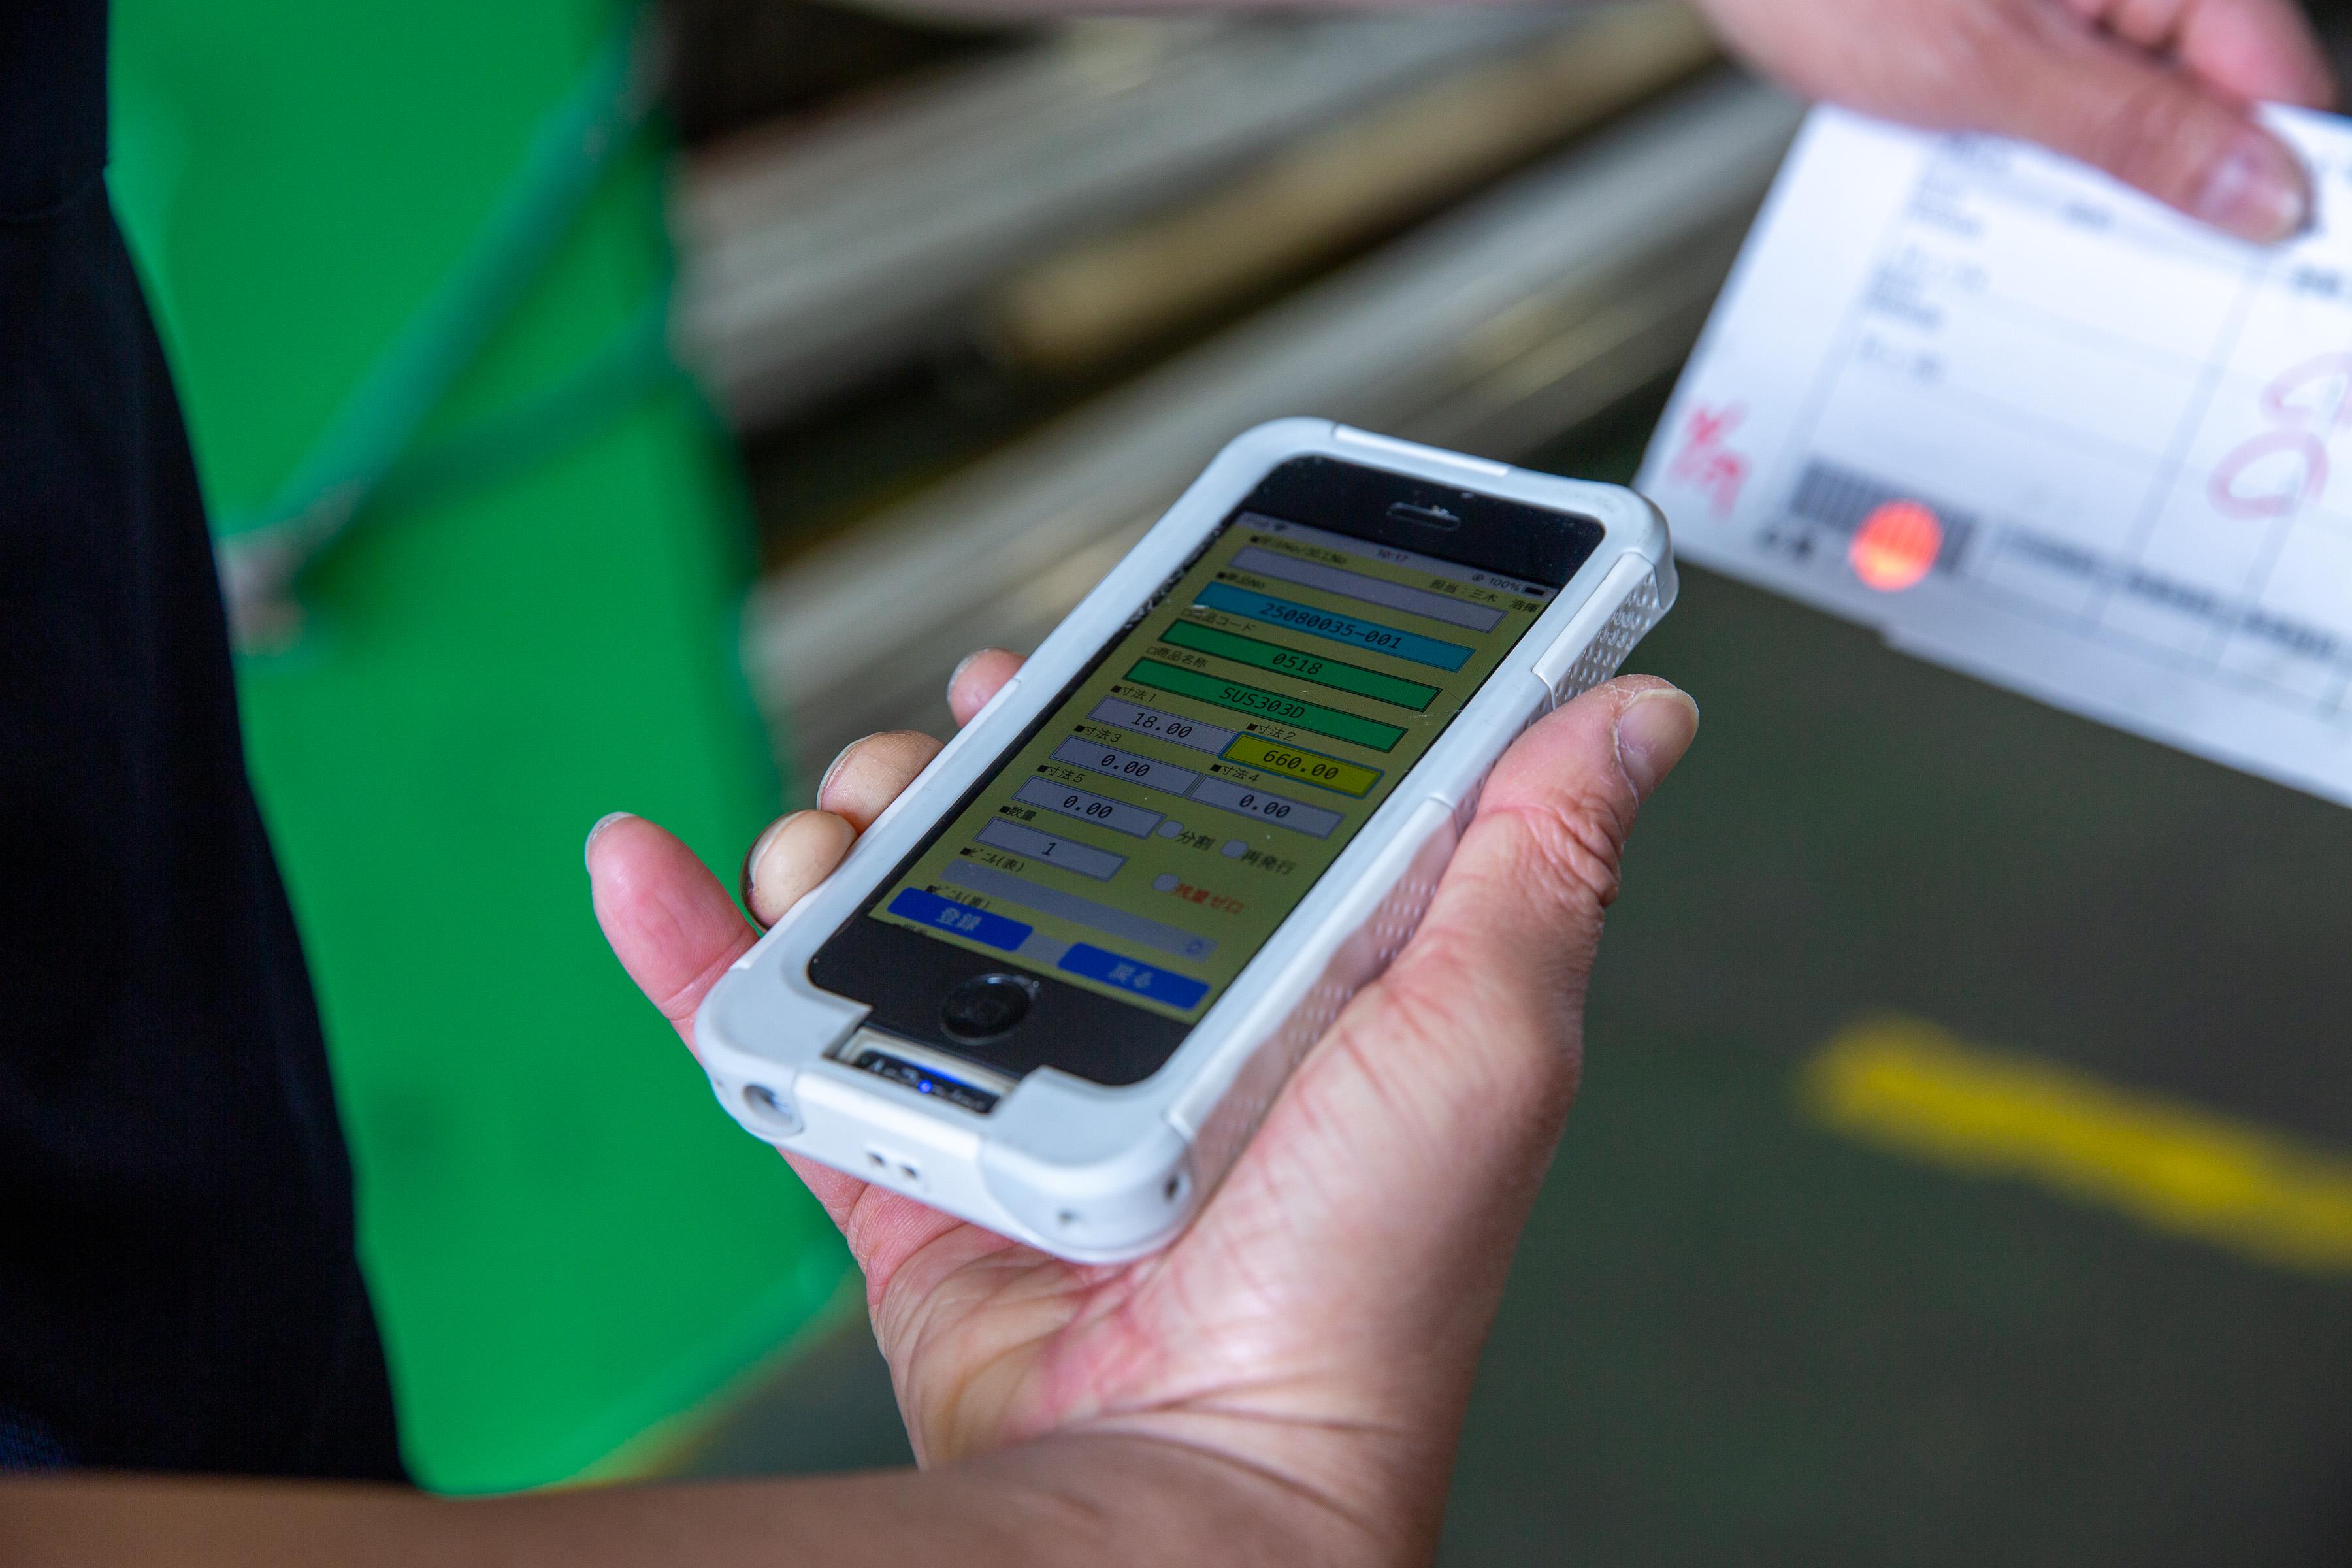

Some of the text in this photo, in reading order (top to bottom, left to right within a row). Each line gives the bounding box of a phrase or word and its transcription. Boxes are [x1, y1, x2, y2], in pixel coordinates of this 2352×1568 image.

[1489, 578, 1522, 591] 100%
[1258, 602, 1403, 651] 25080035-001
[1271, 652, 1324, 676] 0518
[1219, 686, 1305, 720] SUS303D
[1131, 712, 1193, 738] 18.00
[1100, 753, 1151, 777] 0.00
[1262, 750, 1339, 780] 660.00
[1006, 804, 1037, 822] 数量
[1062, 795, 1113, 819] 0.00
[1239, 794, 1291, 818] 0.00
[1041, 842, 1057, 857] 1
